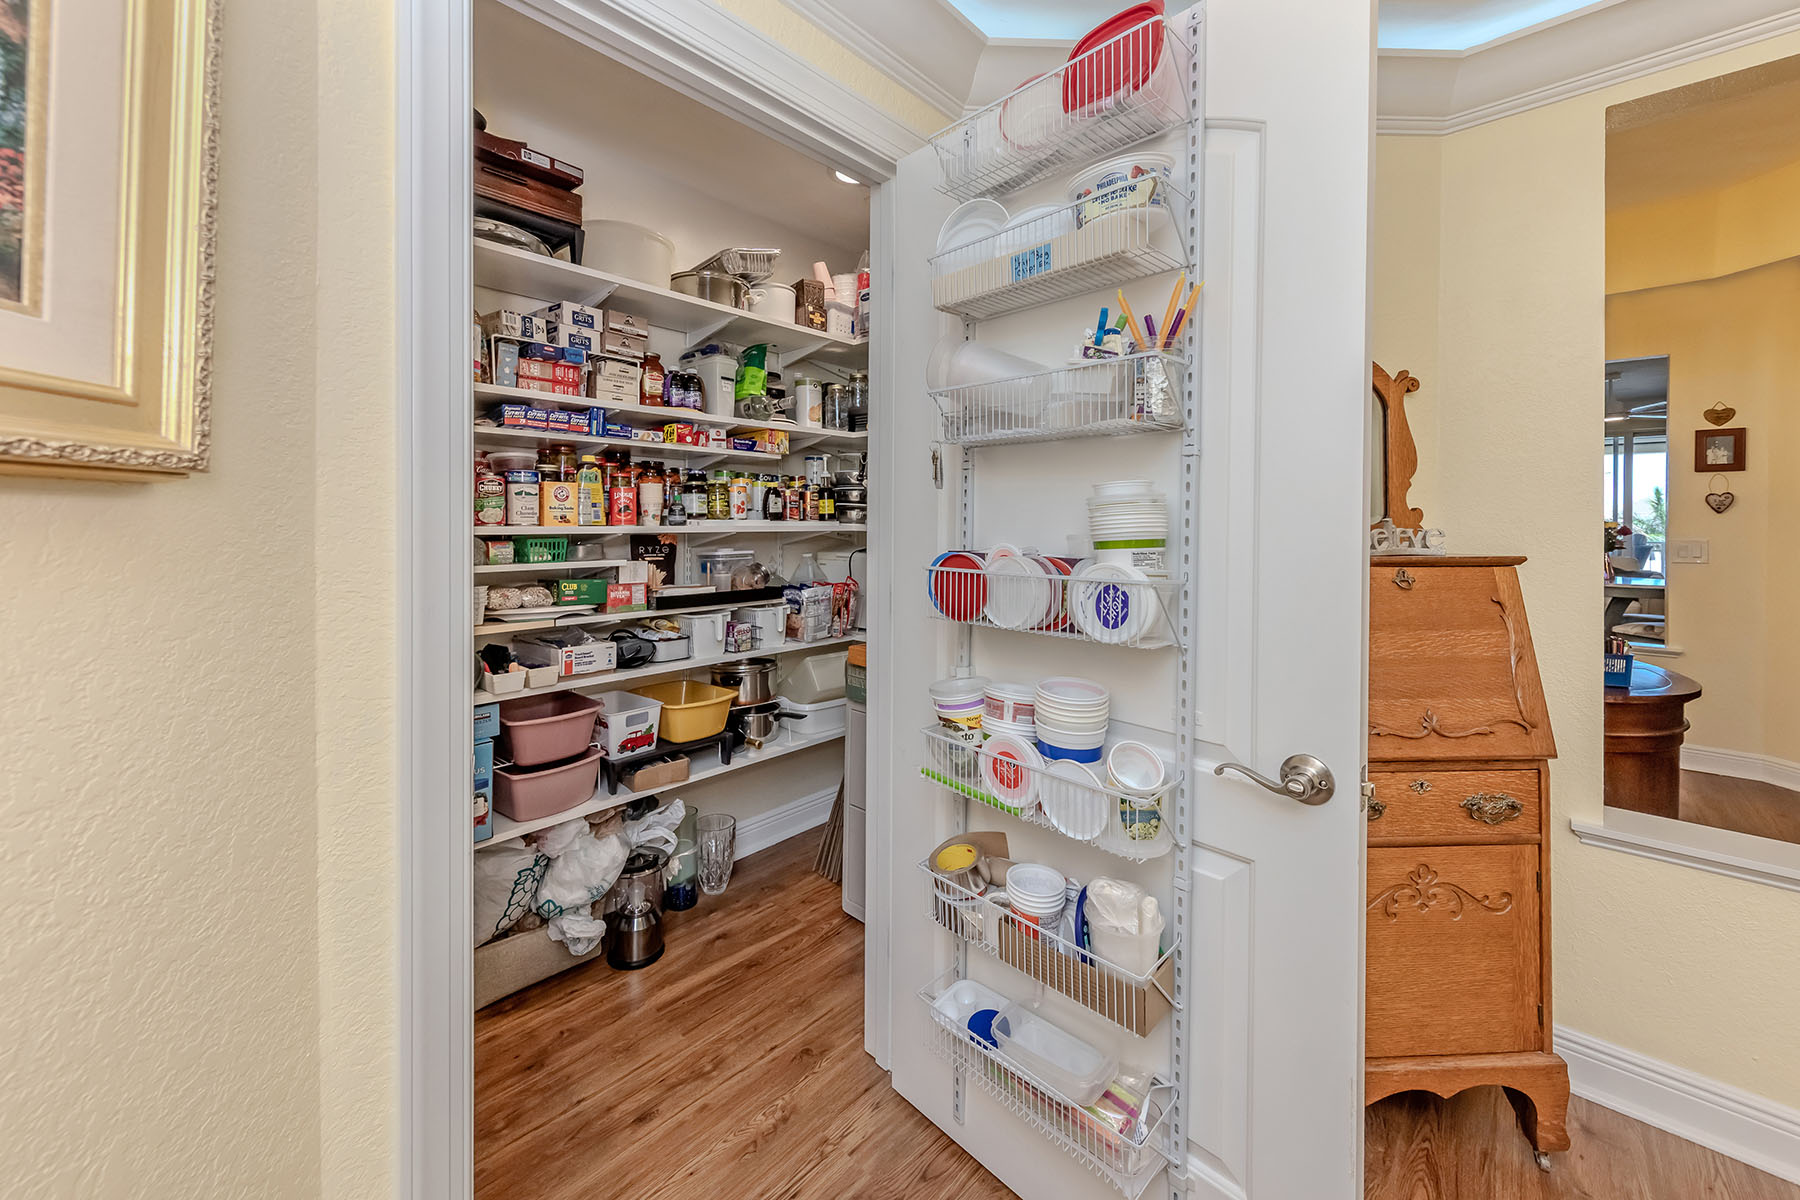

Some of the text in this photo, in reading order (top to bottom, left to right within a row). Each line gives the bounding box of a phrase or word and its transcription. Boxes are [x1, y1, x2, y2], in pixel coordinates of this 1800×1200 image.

[1096, 174, 1128, 191] PHILADELPHIA
[1111, 192, 1128, 201] BAKE
[574, 313, 592, 324] GRITS
[571, 336, 590, 346] GRITS
[561, 583, 578, 591] CLUB
